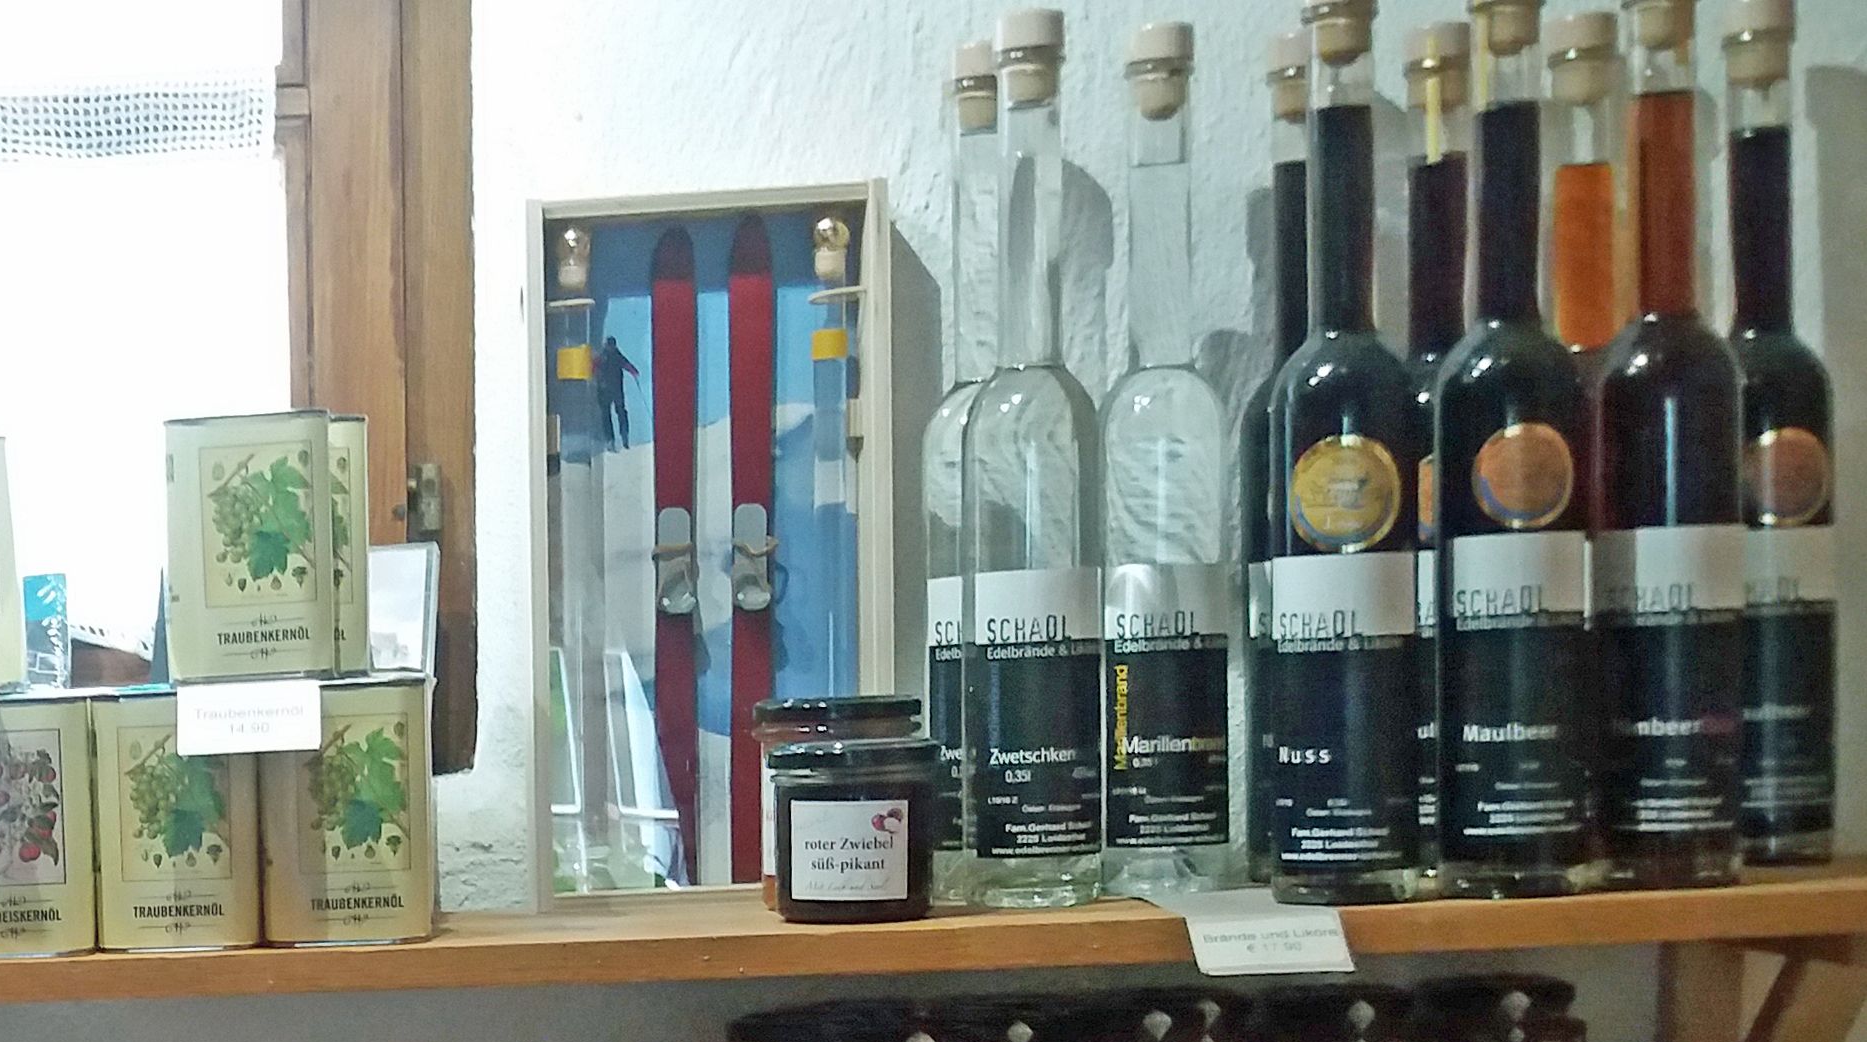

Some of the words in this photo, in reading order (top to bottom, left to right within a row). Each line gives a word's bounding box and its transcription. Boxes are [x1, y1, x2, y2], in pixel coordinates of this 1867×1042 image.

[217, 626, 311, 646] TRAUBENKERNÖL
[989, 747, 1076, 765] Zwetschken
[1279, 746, 1332, 764] Nuss
[805, 839, 836, 851] roter
[840, 836, 893, 851] Zwiebel
[811, 858, 885, 874] süß-pikant
[133, 902, 225, 919] TRAUBENKERNÖL
[311, 894, 405, 912] TRAUBENKERNÖL
[1261, 929, 1289, 939] und
